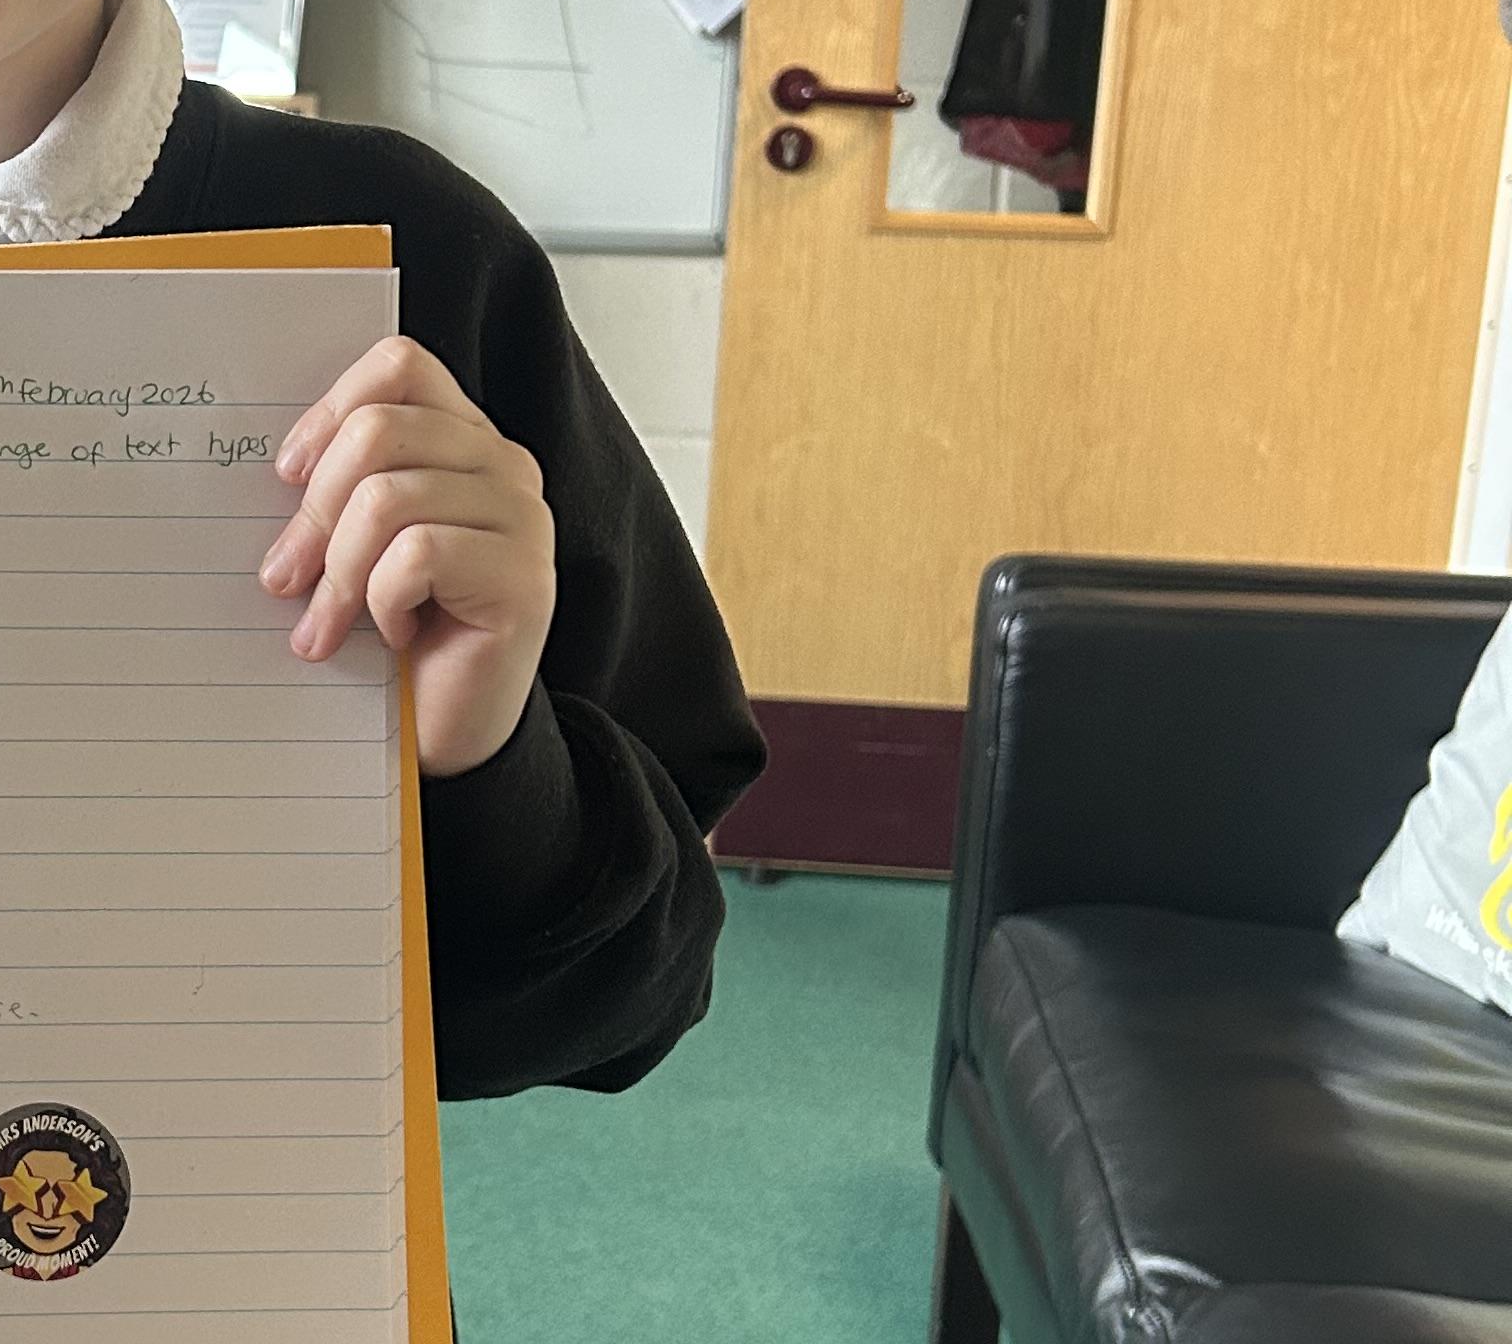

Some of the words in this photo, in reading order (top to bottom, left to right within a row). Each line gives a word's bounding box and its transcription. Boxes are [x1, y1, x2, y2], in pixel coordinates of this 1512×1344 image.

[141, 379, 216, 405] 2026
[71, 441, 104, 466] of
[125, 432, 182, 457] text
[23, 1115, 105, 1152] ANDERSON'S
